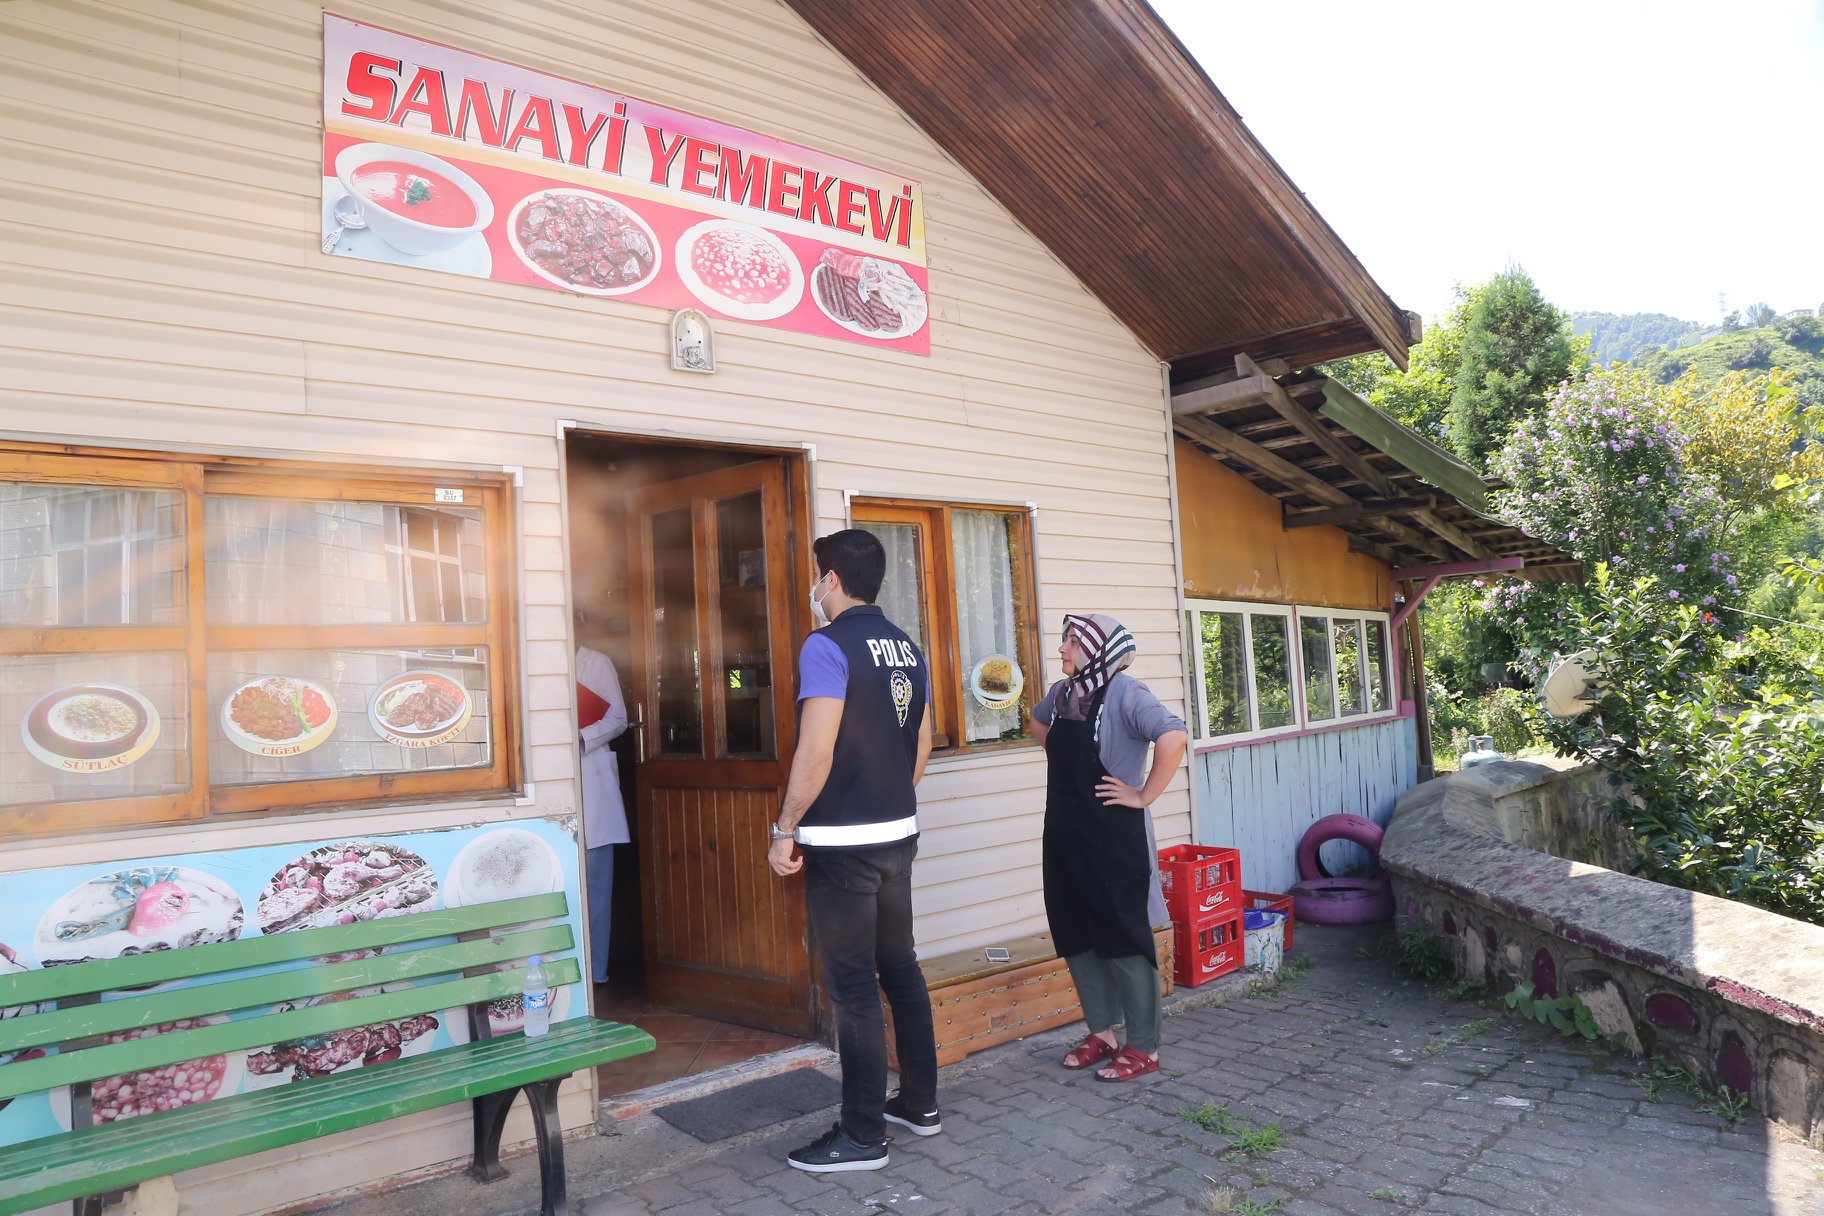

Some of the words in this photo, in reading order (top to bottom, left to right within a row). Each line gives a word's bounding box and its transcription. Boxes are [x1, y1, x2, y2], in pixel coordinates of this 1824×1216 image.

[341, 49, 628, 176] SANAYİ
[643, 123, 914, 250] YEMEKEVİ
[866, 638, 918, 667] POLIS
[63, 754, 128, 771] SÜTLAÇ
